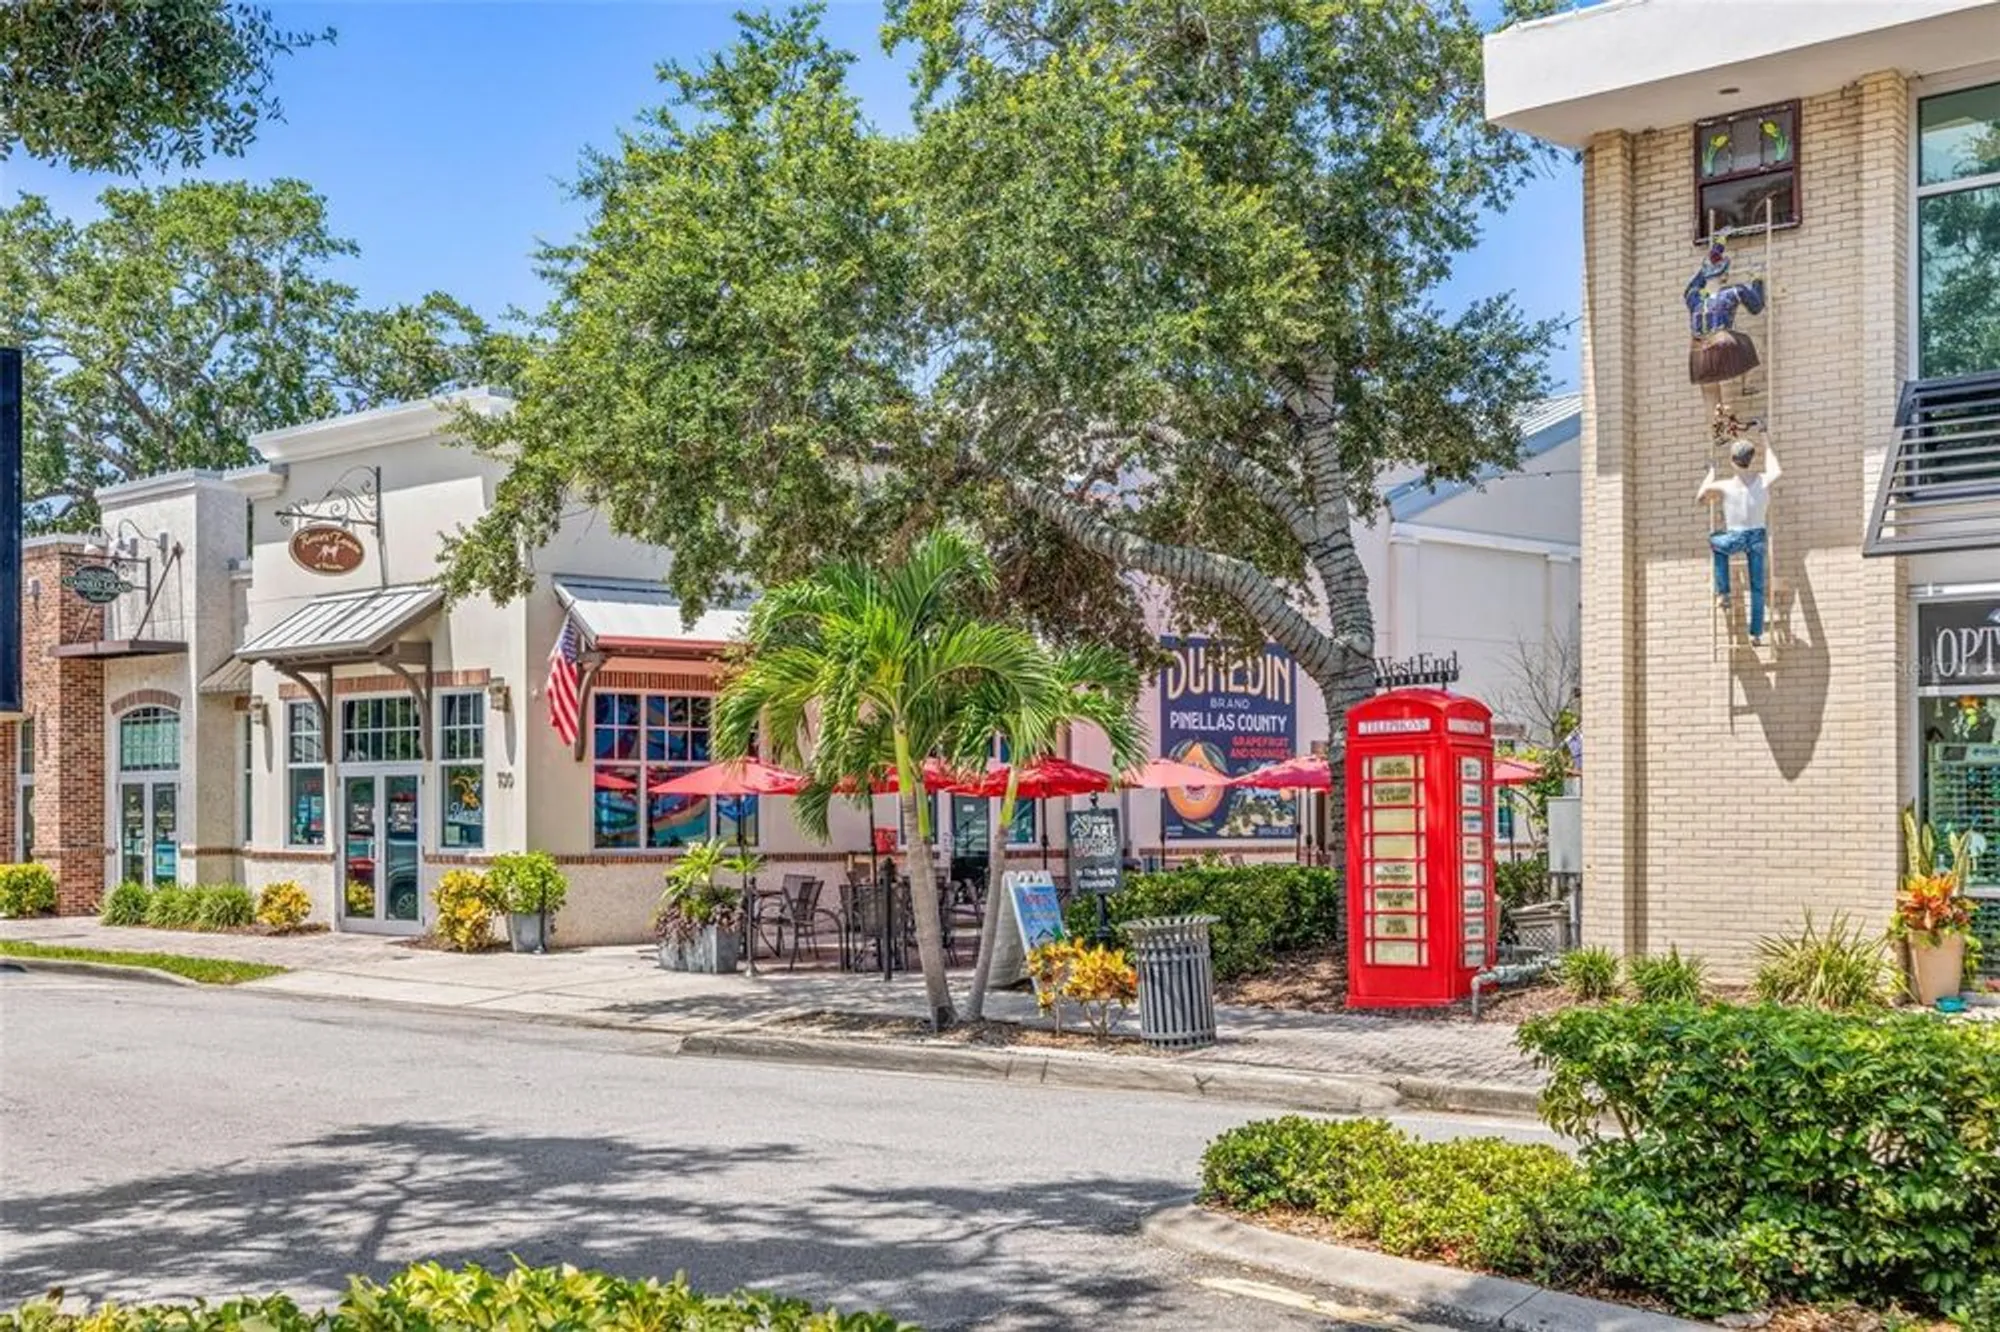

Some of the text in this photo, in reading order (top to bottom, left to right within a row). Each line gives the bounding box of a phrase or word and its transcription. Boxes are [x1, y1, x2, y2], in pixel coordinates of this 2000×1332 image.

[1373, 651, 1458, 676] West End
[1210, 697, 1250, 710] BRAND
[1169, 711, 1288, 733] PINELLAS COUNTY
[1230, 748, 1249, 758] AND
[1092, 824, 1114, 838] ART
